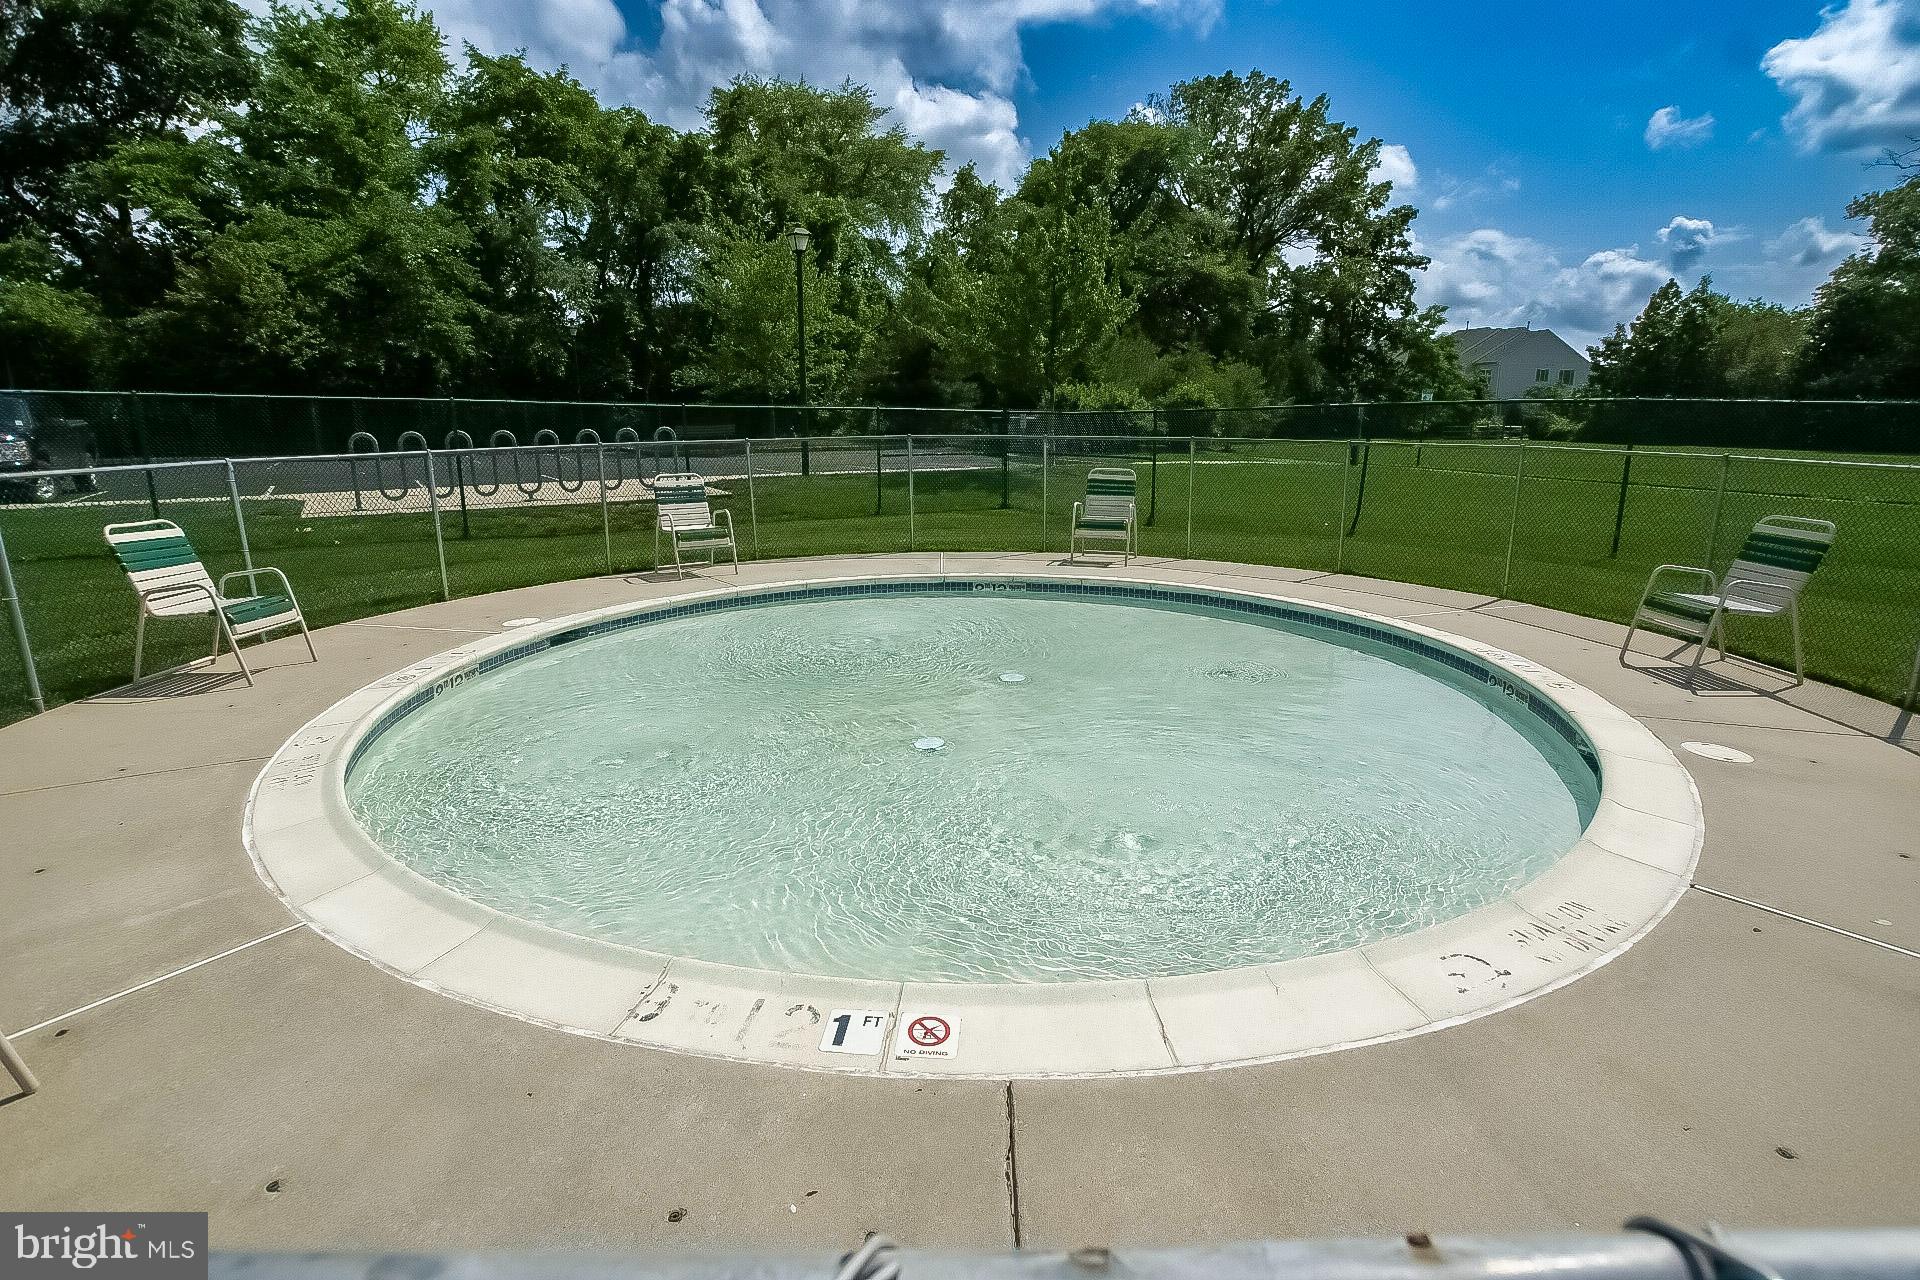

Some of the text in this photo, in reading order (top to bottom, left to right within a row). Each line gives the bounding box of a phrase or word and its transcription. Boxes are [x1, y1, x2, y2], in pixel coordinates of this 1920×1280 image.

[832, 1014, 884, 1046] 1 FT
[918, 1049, 949, 1057] DIVING
